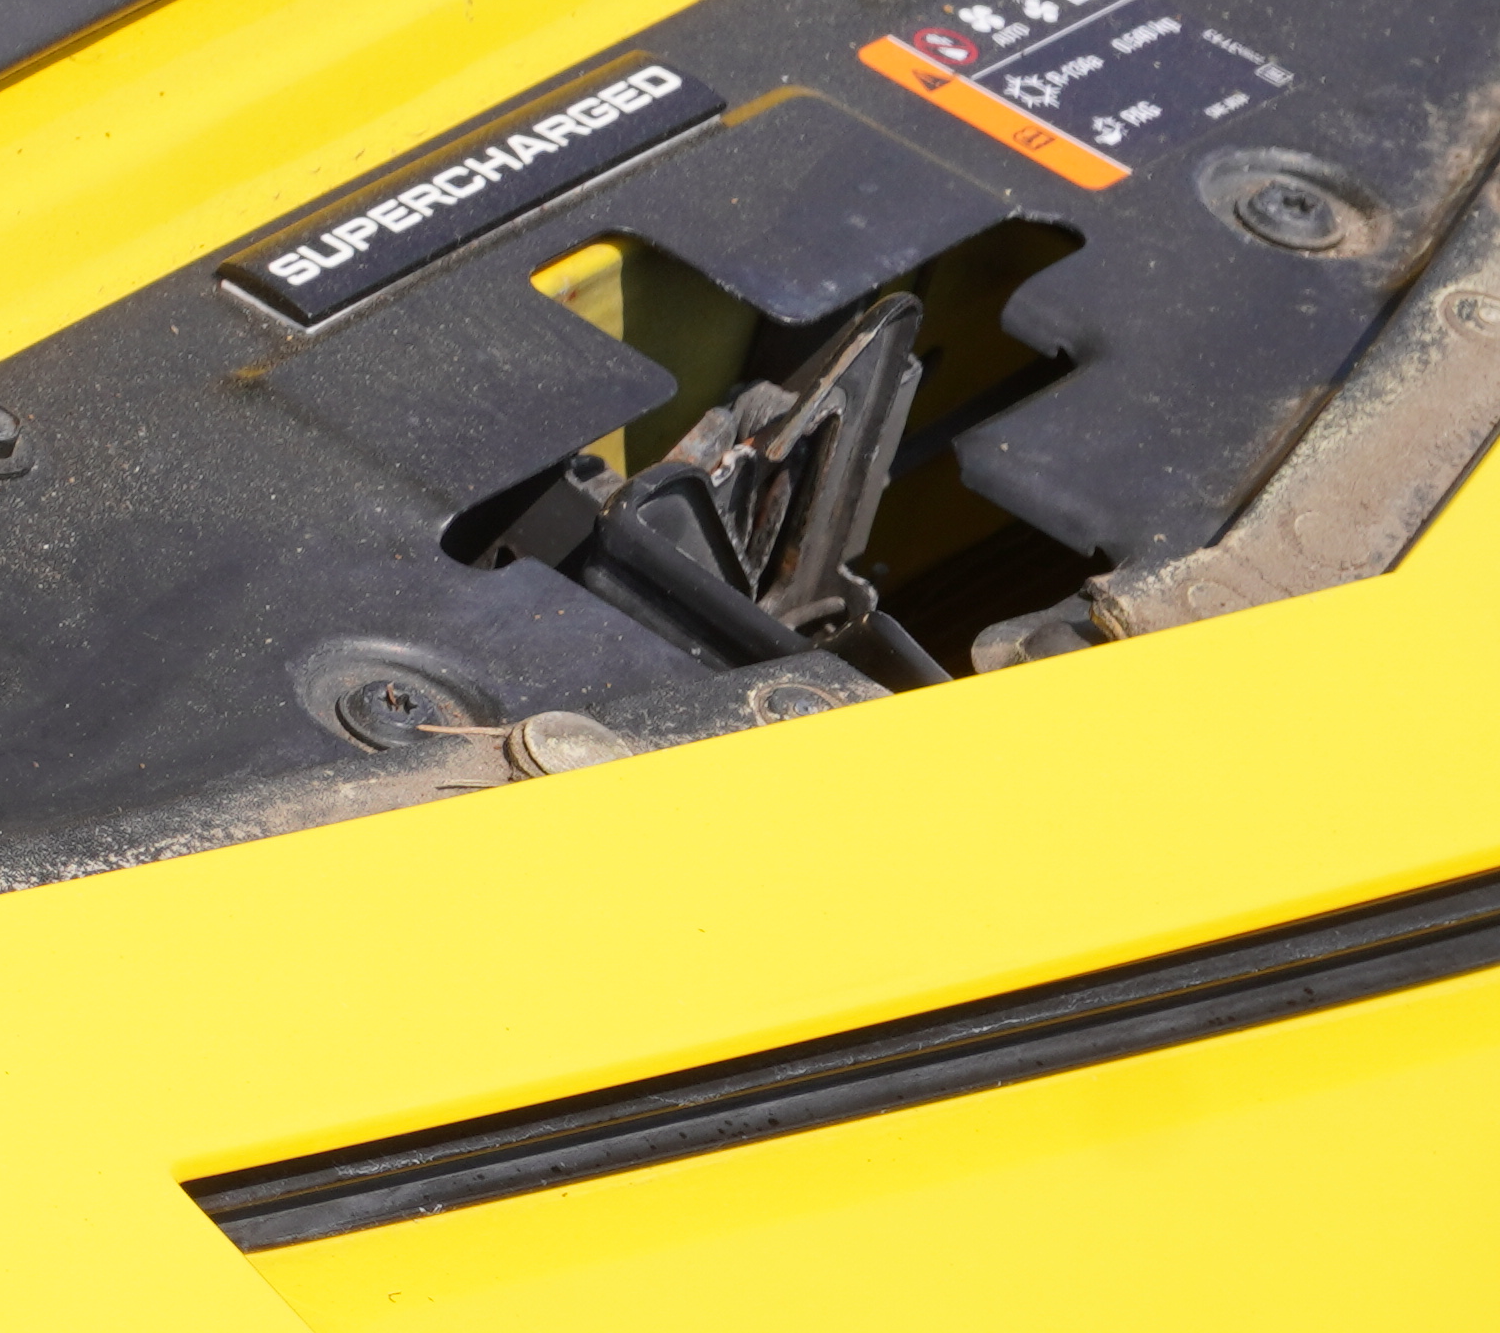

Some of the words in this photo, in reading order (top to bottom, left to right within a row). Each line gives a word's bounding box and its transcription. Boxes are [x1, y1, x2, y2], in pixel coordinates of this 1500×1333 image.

[992, 22, 1031, 48] AUTO
[1119, 100, 1163, 127] PAG
[268, 64, 683, 287] SUPERCHARGED
